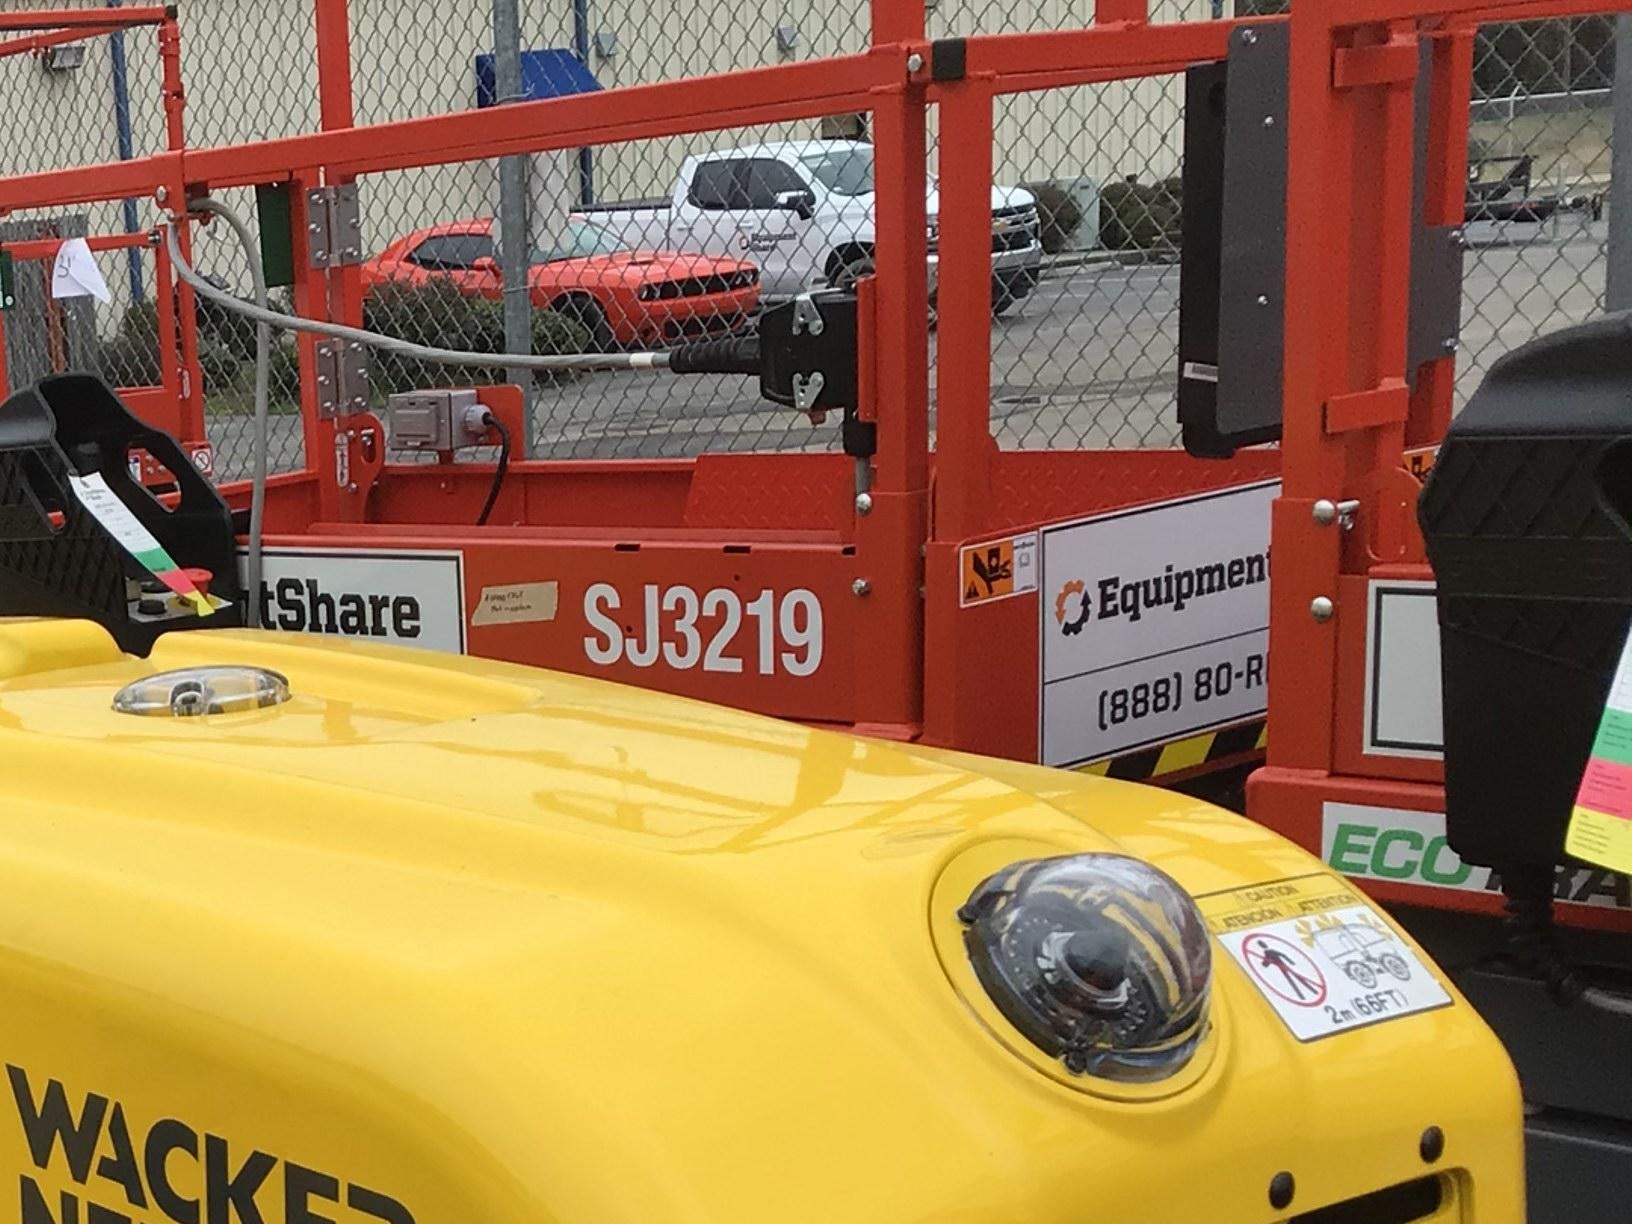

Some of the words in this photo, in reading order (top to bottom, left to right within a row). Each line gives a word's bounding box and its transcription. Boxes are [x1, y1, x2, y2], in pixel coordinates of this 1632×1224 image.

[583, 582, 824, 677] SJ3219
[1098, 671, 1183, 732] (888)
[1194, 653, 1269, 702] 80-R
[1245, 884, 1300, 902] CAUTION
